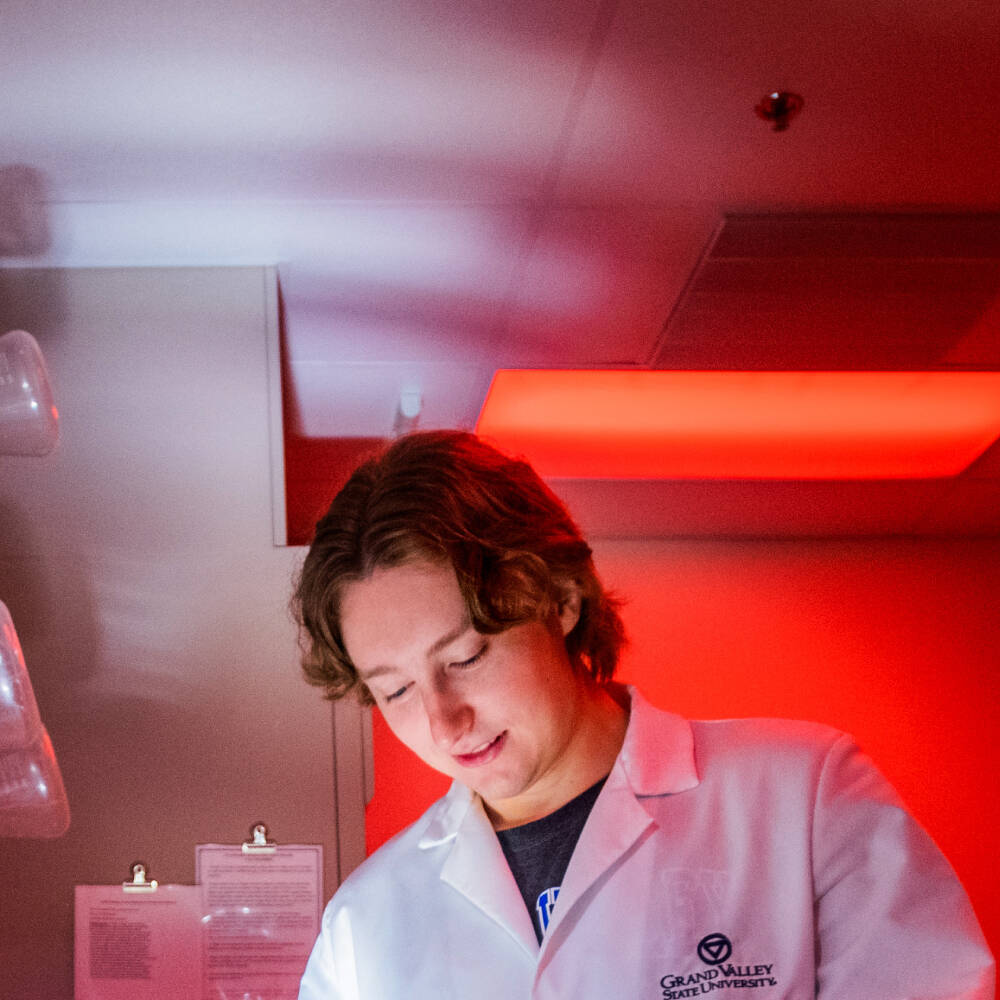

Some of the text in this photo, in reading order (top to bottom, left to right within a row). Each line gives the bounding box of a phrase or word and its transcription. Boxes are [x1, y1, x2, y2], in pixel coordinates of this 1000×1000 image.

[660, 963, 774, 990] GRAND VALLEY
[662, 986, 701, 1000] STATE
